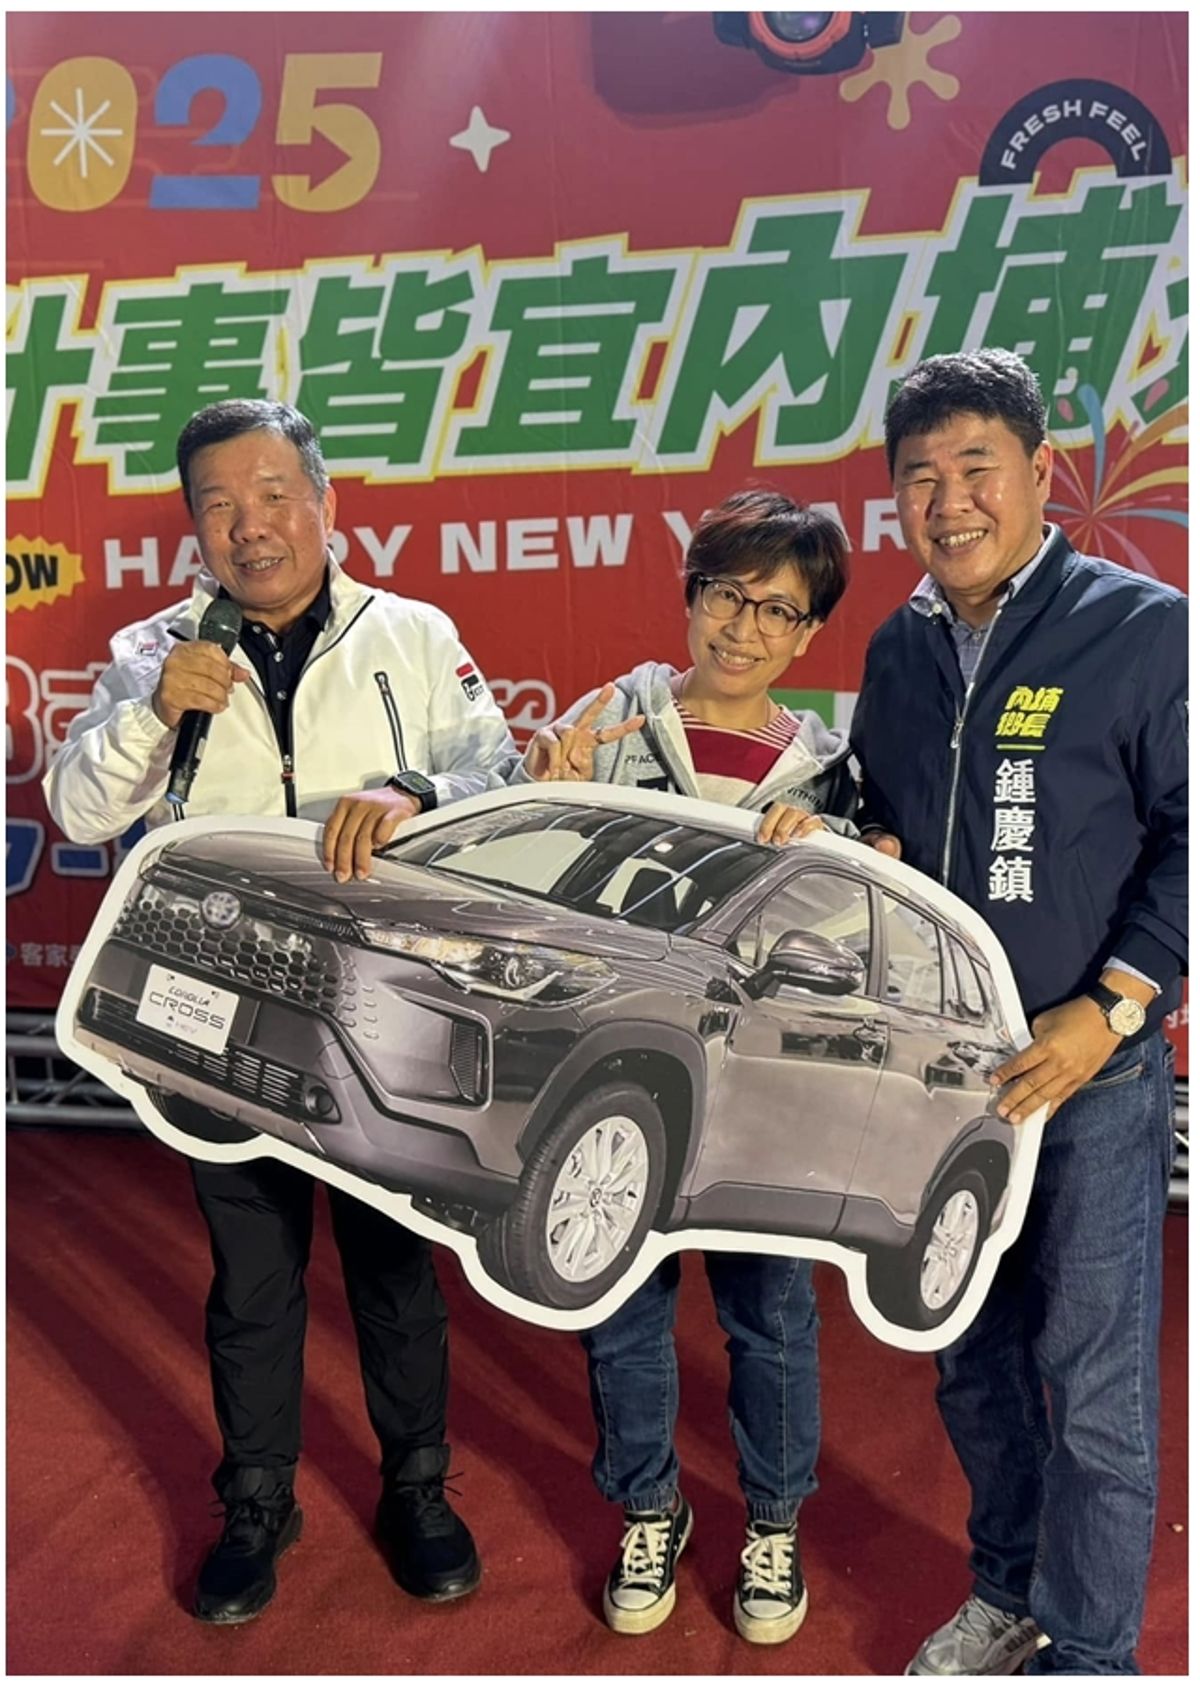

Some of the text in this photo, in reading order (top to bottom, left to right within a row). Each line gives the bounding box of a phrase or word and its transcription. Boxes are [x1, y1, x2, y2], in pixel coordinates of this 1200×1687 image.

[6, 52, 384, 212] 025
[1001, 99, 1148, 170] FRESH FEEL
[440, 513, 633, 574] NEW
[148, 991, 227, 1030] CROSS
